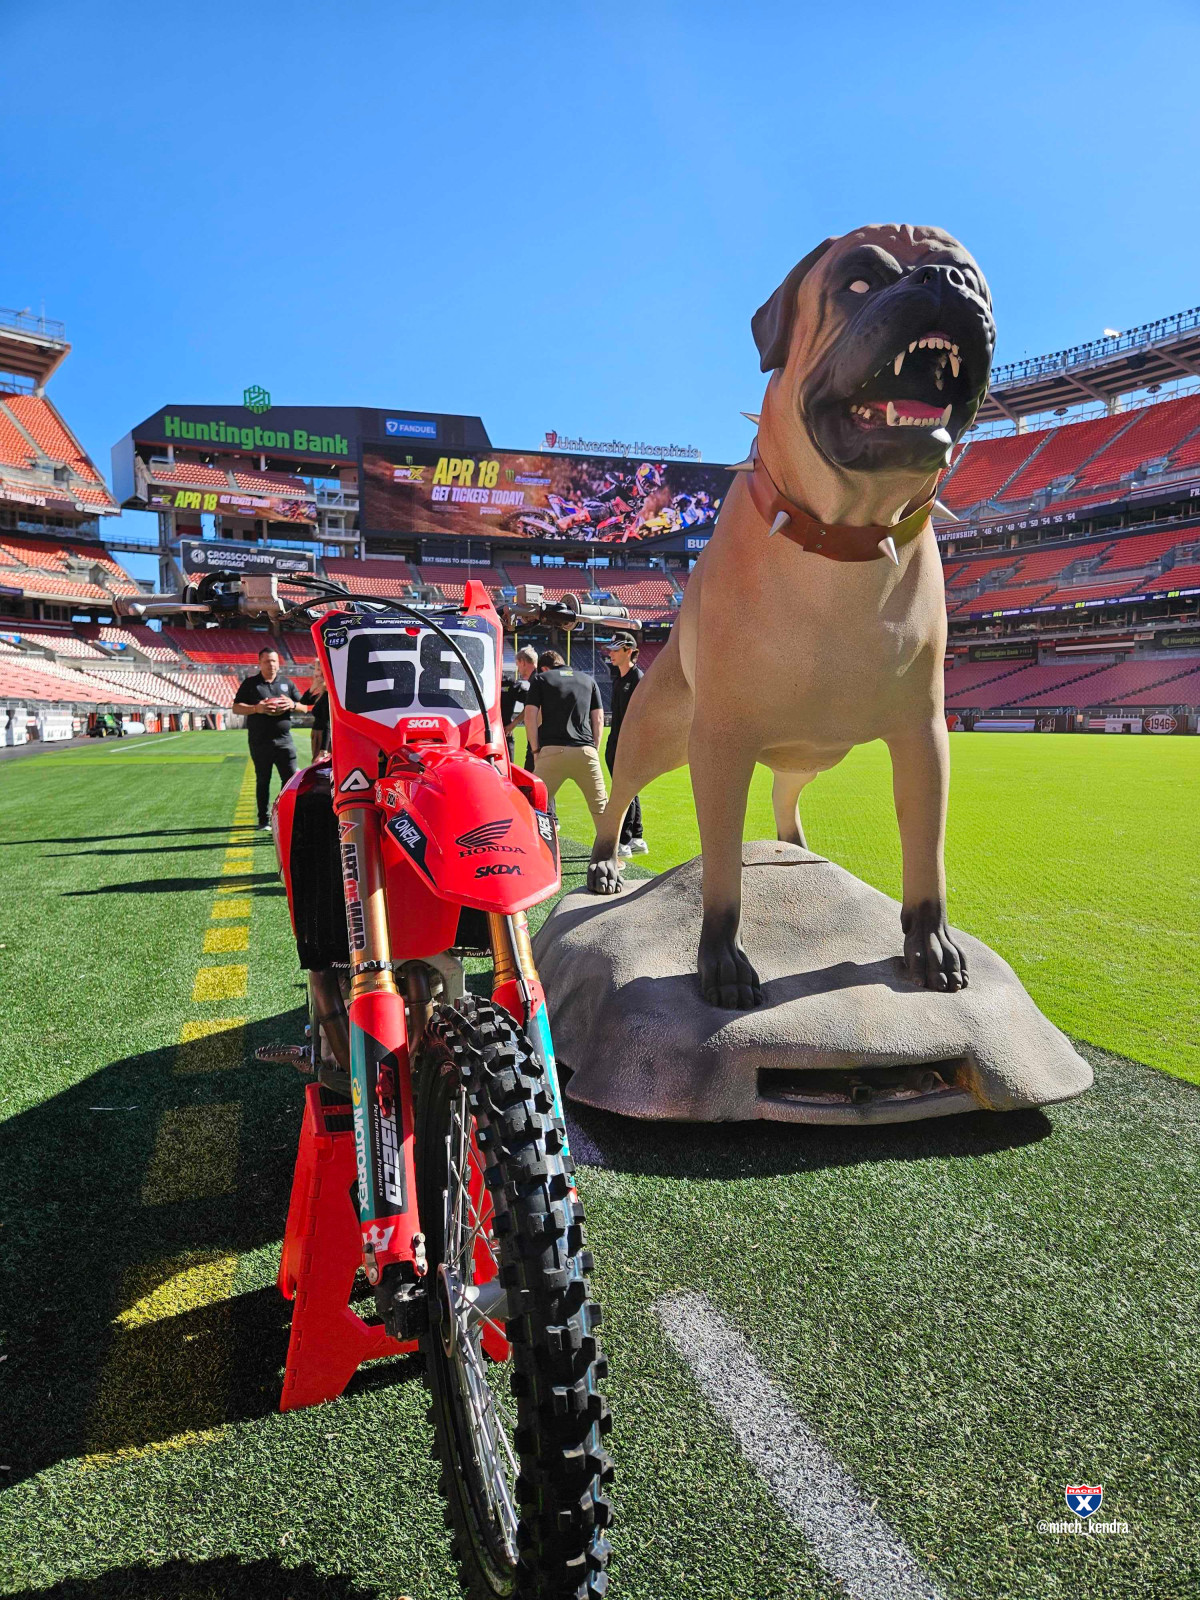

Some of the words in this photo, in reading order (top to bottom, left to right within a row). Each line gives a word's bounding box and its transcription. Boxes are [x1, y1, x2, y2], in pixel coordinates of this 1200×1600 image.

[164, 415, 290, 450] Huntington
[293, 429, 348, 455] Bank
[399, 424, 436, 434] FANDUEL
[557, 436, 632, 457] University
[635, 441, 699, 460] Hospitals
[432, 457, 475, 487] APR
[477, 460, 500, 488] 18
[431, 486, 451, 501] GET
[451, 487, 489, 504] TICKETS
[491, 490, 524, 506] TODAY!
[1190, 488, 1200, 497] FR
[174, 490, 202, 510] APR
[203, 493, 218, 511] 18
[936, 529, 978, 541] AMPIONSHIPS
[994, 525, 1003, 533] '47
[206, 550, 276, 565] CROSSCOUNTRY
[207, 559, 246, 568] MORTGAGE
[277, 560, 308, 570] LANDING
[345, 634, 485, 713] 68
[406, 719, 440, 729] SKDA
[1150, 718, 1171, 730] 1946
[394, 818, 422, 849] ONEAL
[458, 846, 527, 858] HONDA
[474, 864, 522, 879] SKDA
[466, 950, 484, 958] Twin
[484, 948, 492, 956] A
[331, 961, 351, 969] Twin
[373, 1103, 382, 1157] Performance
[353, 1107, 370, 1214] MOTOREX
[376, 1158, 384, 1197] Products
